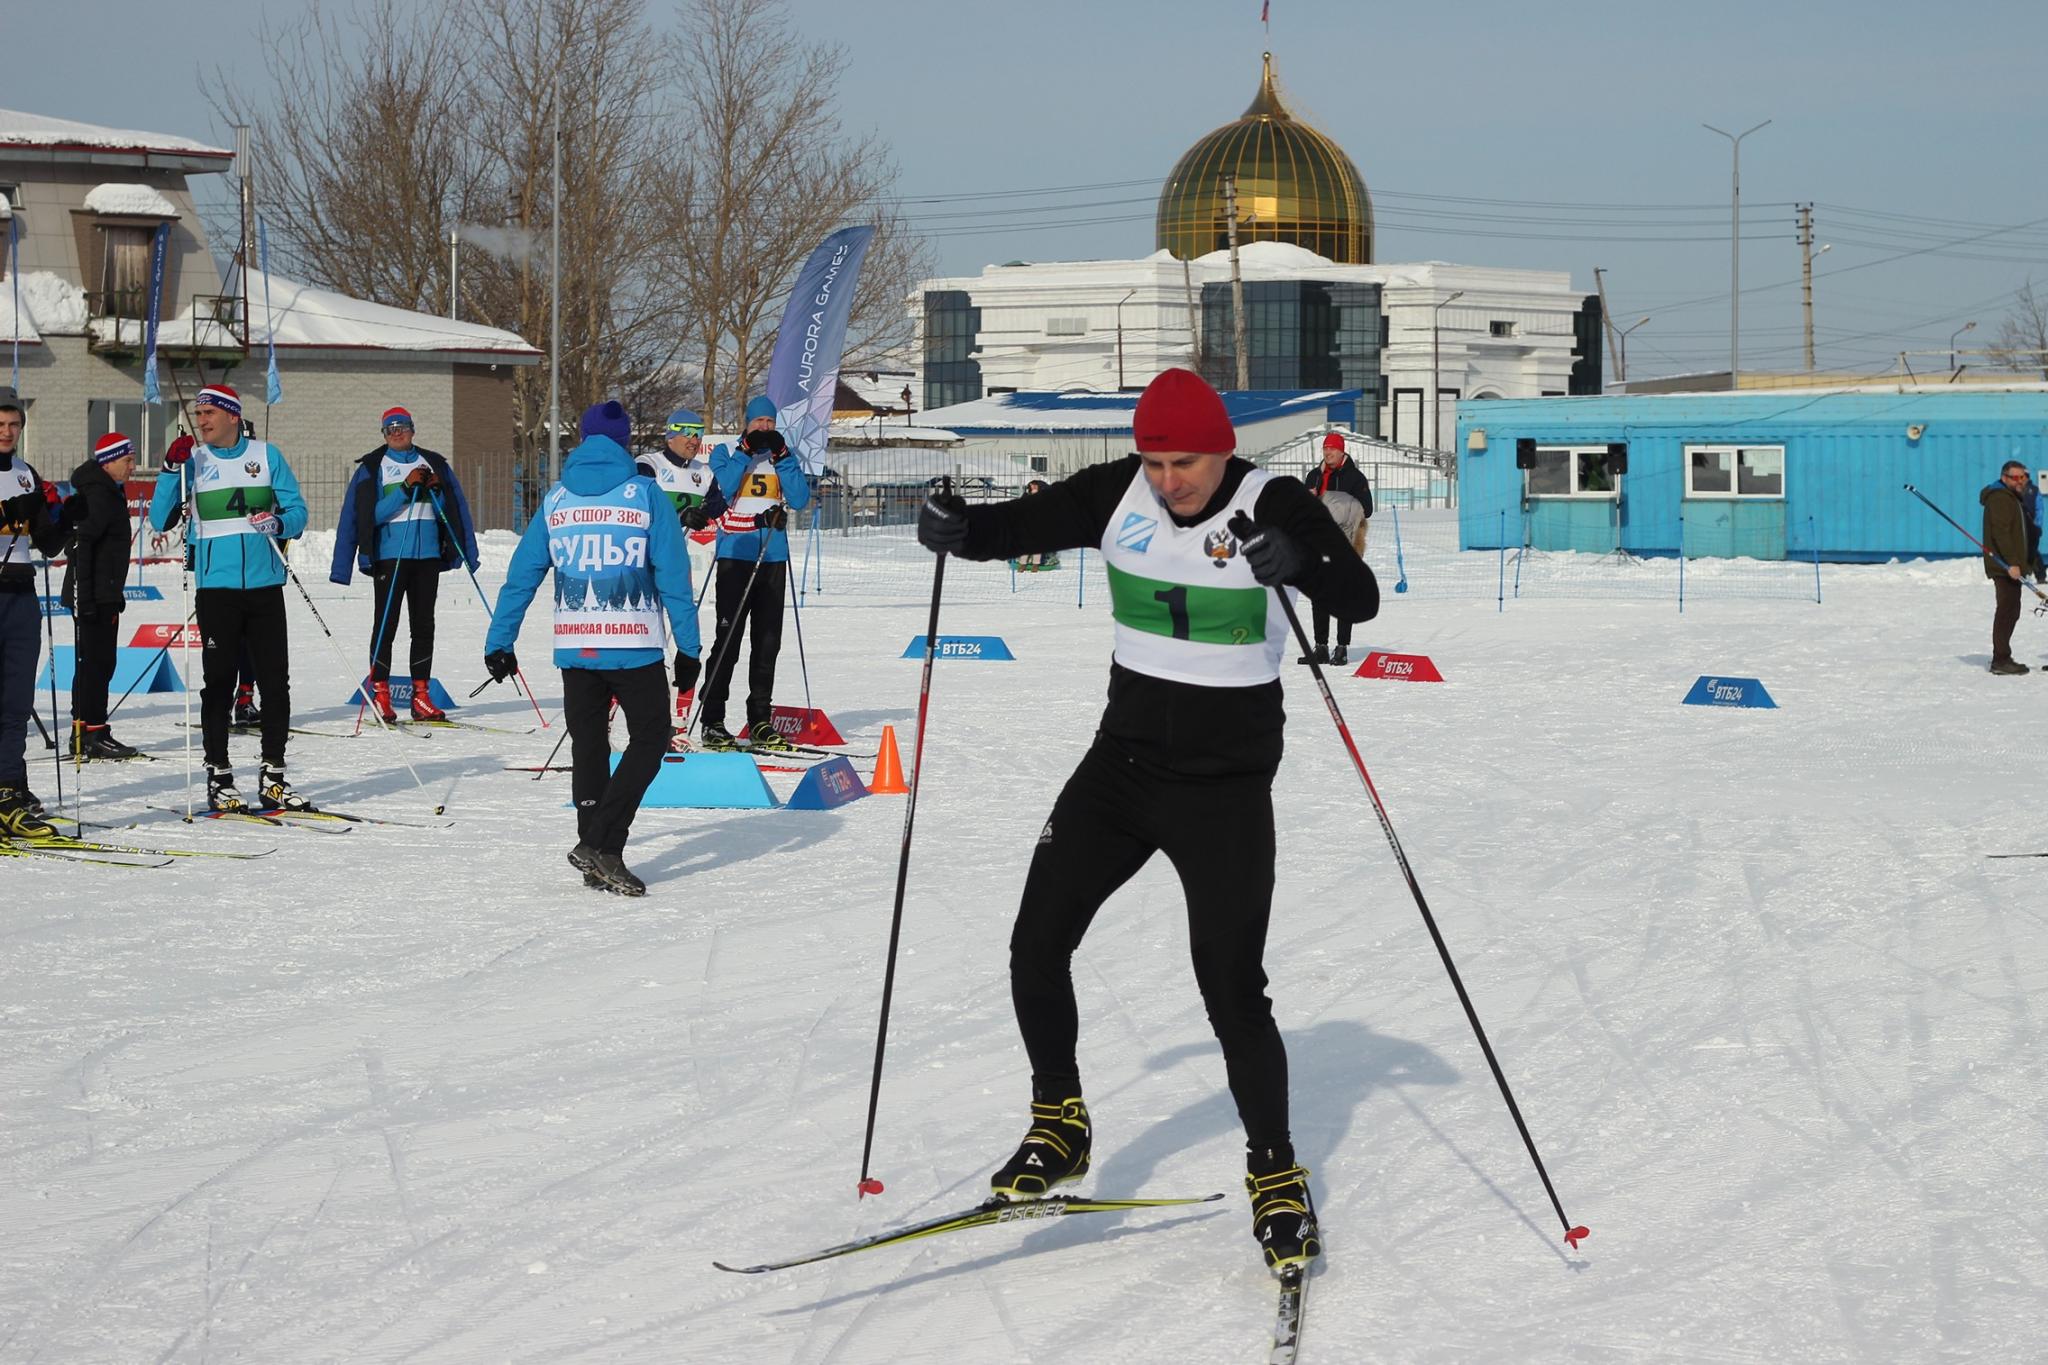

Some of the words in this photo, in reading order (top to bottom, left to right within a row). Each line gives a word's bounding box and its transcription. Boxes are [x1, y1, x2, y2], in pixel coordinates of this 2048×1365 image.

[798, 311, 824, 392] AURORA
[623, 483, 638, 499] 8
[751, 474, 767, 497] 5
[226, 487, 249, 517] 4
[550, 511, 567, 526] БУ
[573, 508, 612, 523] СШОР
[617, 509, 642, 525] ЗВС
[549, 534, 648, 572] СУДЬЯ
[1154, 586, 1189, 641] 1
[604, 623, 649, 636] ОБЛАСТЬ
[1231, 626, 1249, 645] 2
[942, 643, 982, 655] ВТБ24
[1384, 661, 1414, 675] ВТБ24
[389, 684, 414, 700] ВТБ2
[1714, 686, 1744, 700] ВТБ24
[772, 716, 803, 734] ВТБ24
[998, 1202, 1067, 1223] FISCHER
